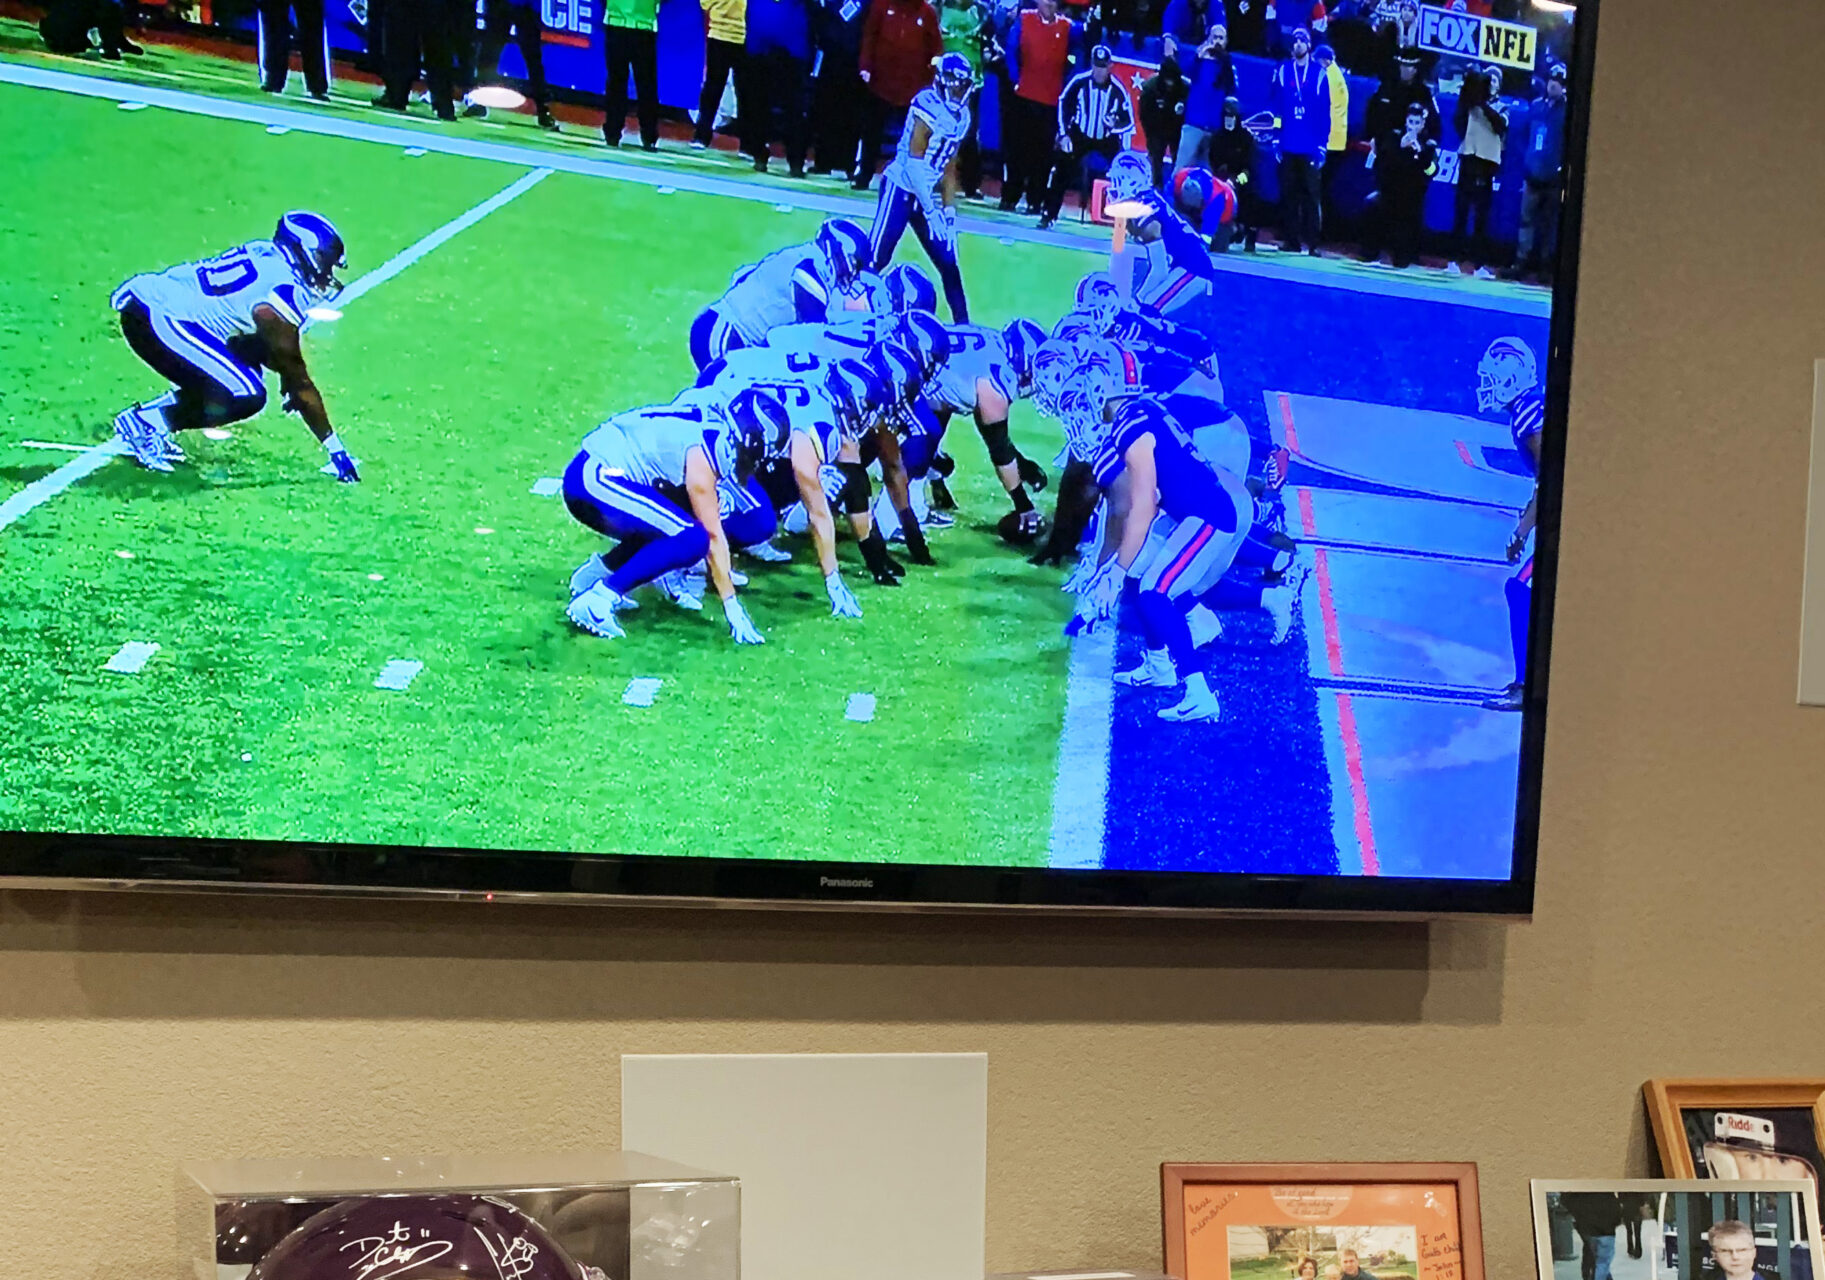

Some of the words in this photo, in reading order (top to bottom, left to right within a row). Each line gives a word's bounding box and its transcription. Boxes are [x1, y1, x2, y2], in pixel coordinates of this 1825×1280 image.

[1422, 10, 1478, 54] FOX
[1483, 24, 1531, 63] NFL
[820, 877, 874, 888] Panasonic
